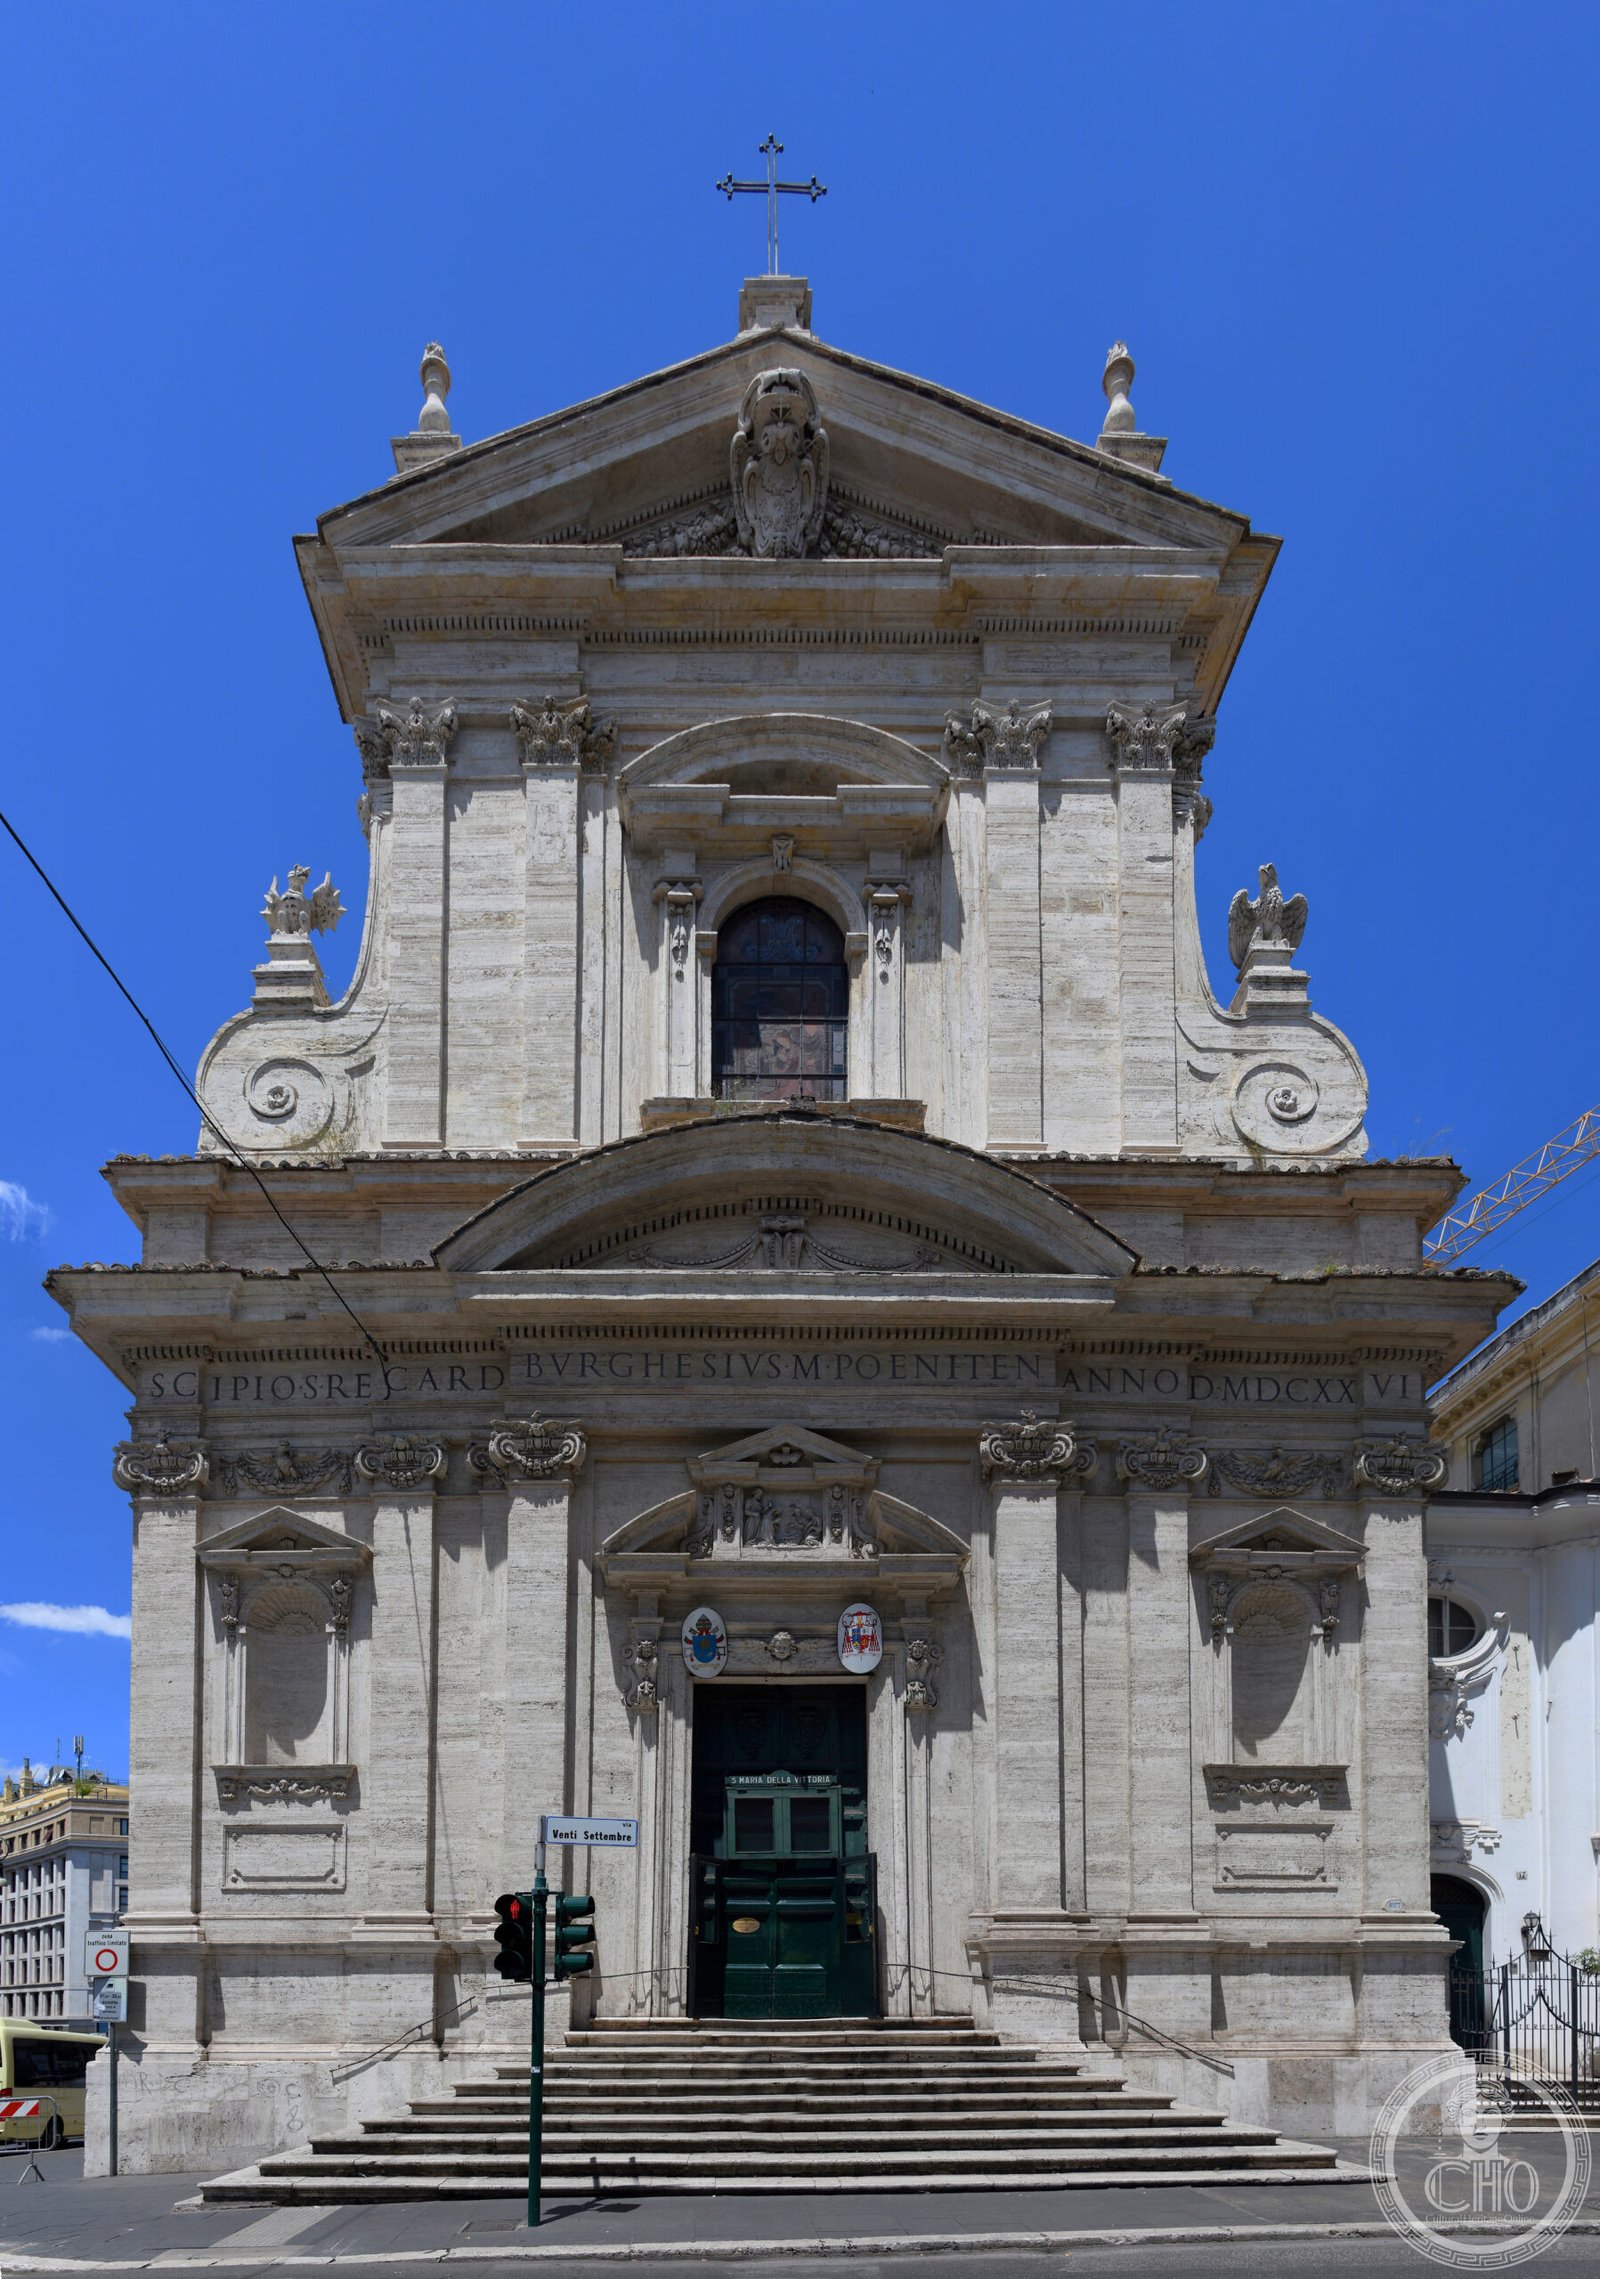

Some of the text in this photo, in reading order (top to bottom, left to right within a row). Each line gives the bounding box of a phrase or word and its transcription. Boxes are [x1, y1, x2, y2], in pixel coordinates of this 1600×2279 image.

[1062, 1367, 1180, 1394] ANNO
[739, 1776, 763, 1784] MARIA
[767, 1776, 791, 1784] DELLA
[794, 1775, 831, 1784] VITTORIA
[552, 1829, 633, 1842] Venti Settembre
